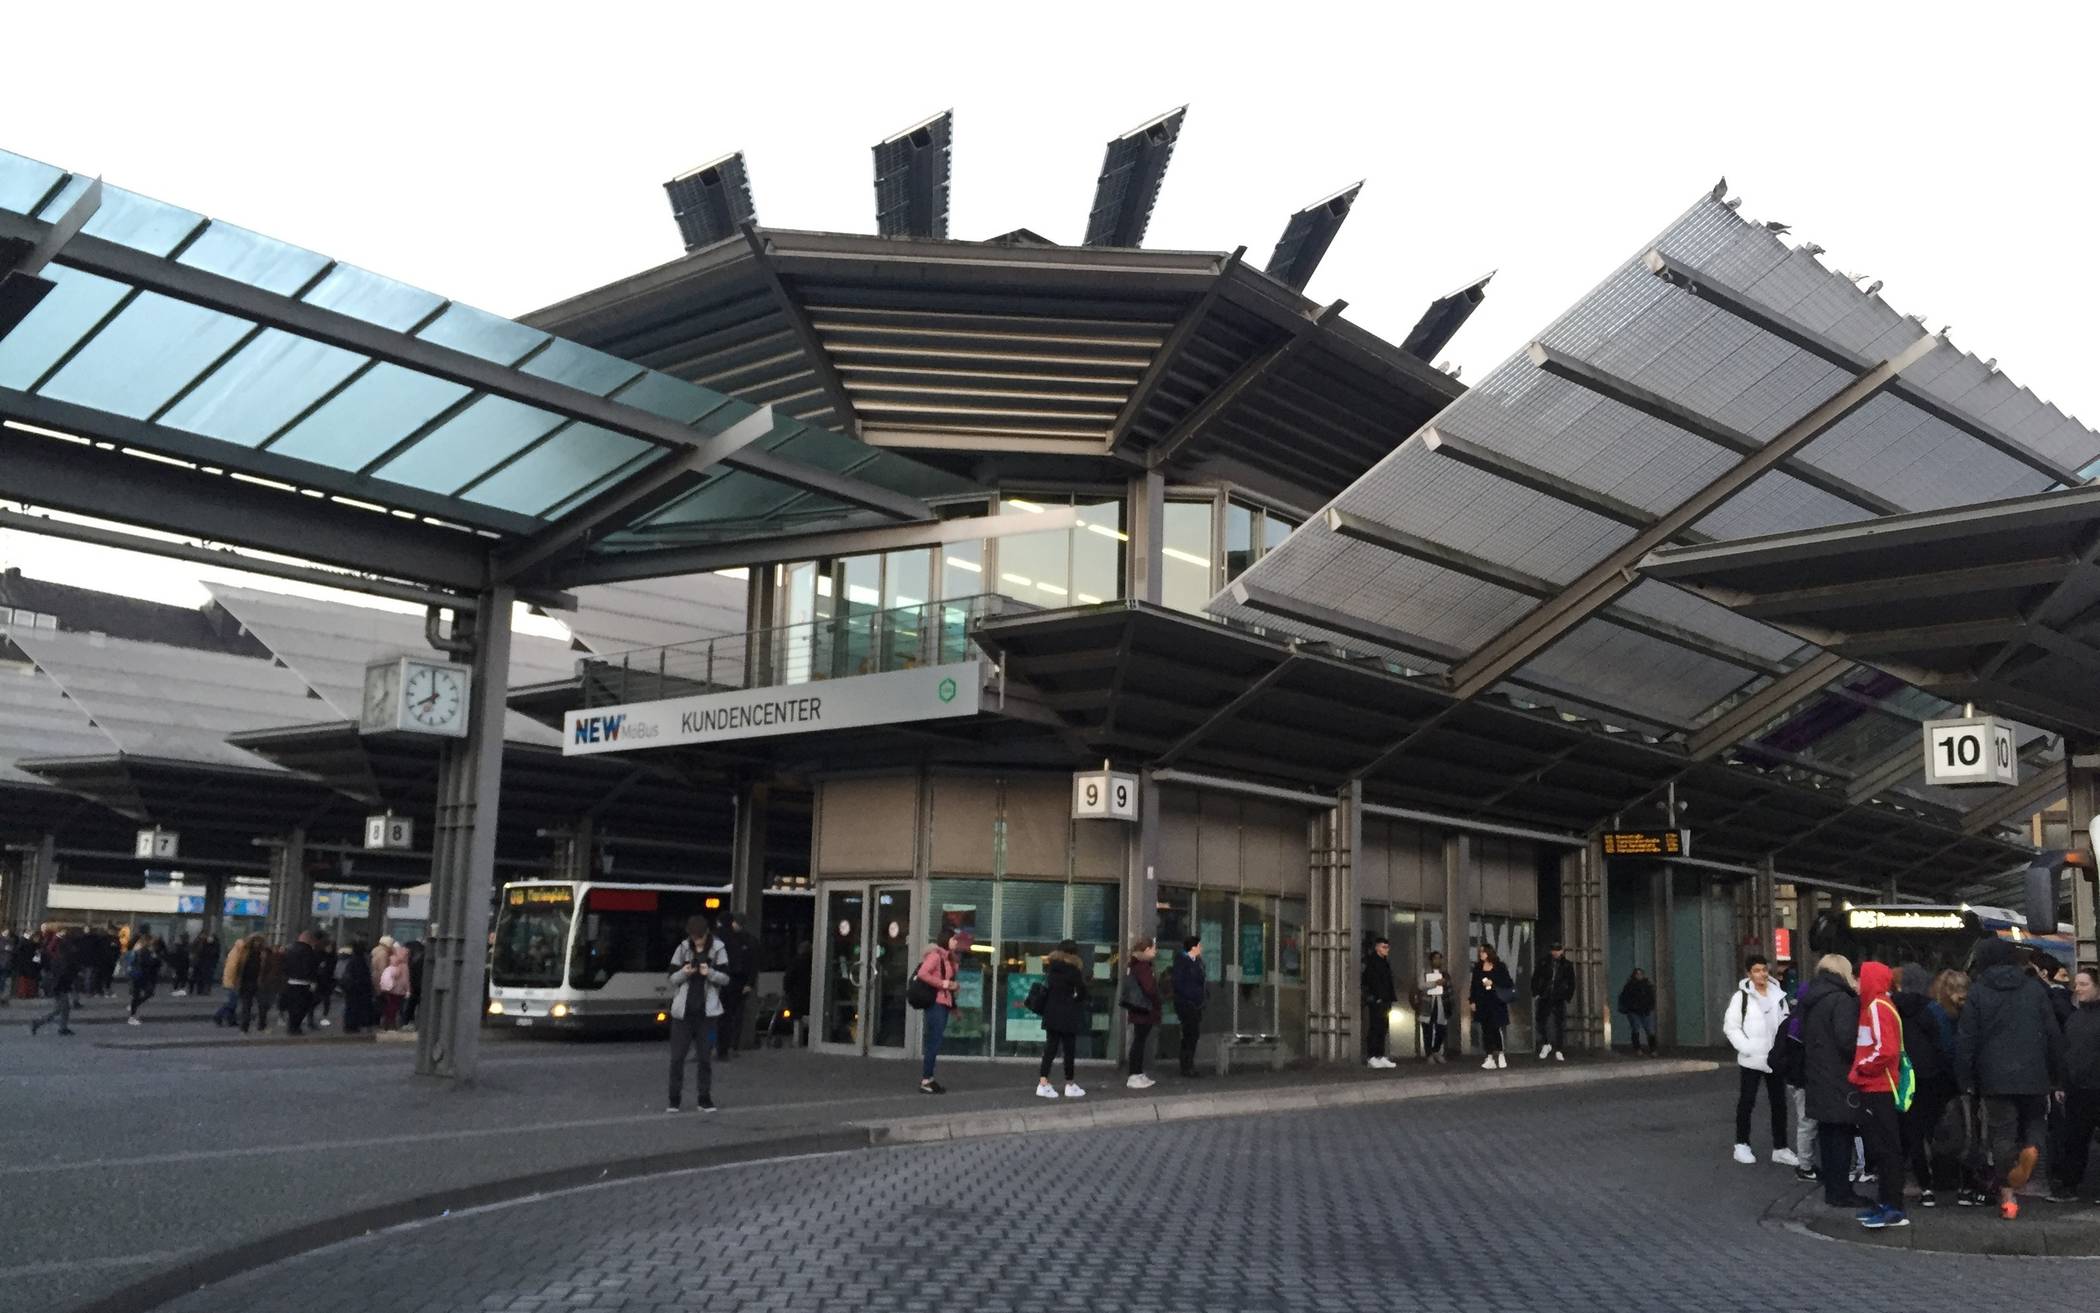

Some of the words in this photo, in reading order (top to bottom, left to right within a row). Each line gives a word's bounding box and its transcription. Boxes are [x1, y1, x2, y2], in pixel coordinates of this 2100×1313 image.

[682, 698, 821, 733] KUNDENCENTER
[1938, 734, 1981, 767] 10
[1995, 735, 2009, 768] 10
[1086, 783, 1098, 807] 9
[1116, 785, 1127, 808] 9
[373, 824, 381, 841] 8
[392, 824, 402, 841] 8
[160, 839, 169, 851] 7
